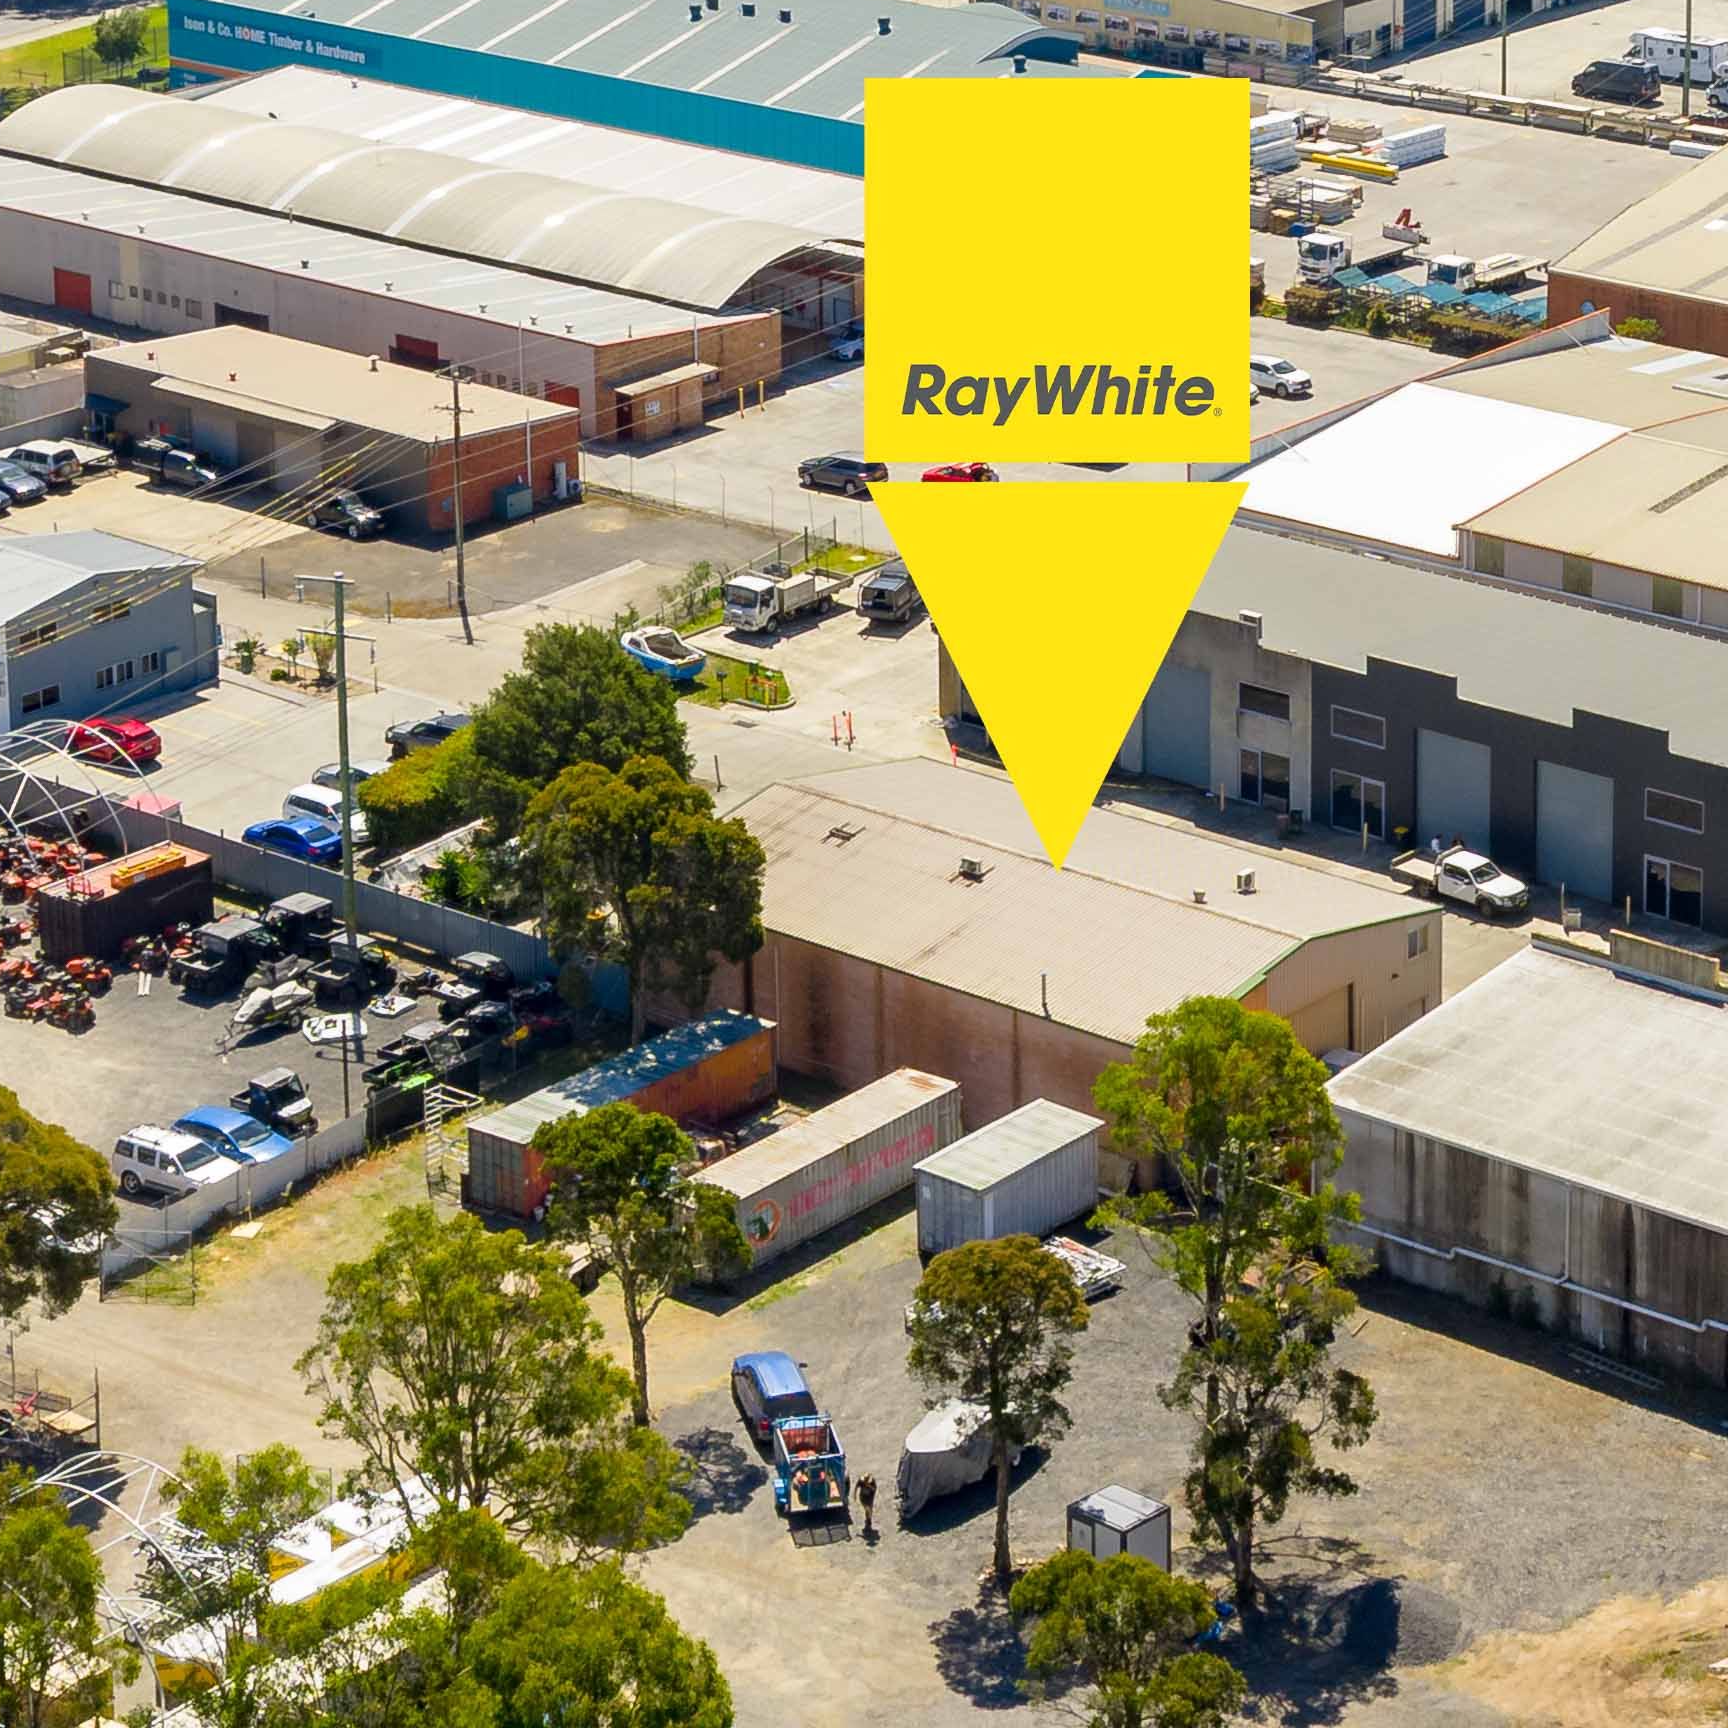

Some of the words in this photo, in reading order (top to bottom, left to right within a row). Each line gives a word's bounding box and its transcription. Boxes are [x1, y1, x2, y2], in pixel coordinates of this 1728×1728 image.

[207, 19, 216, 34] &
[217, 21, 233, 38] Co.
[234, 24, 266, 44] HOME
[267, 31, 303, 52] Timber
[305, 39, 314, 53] &
[315, 41, 366, 65] Hardware
